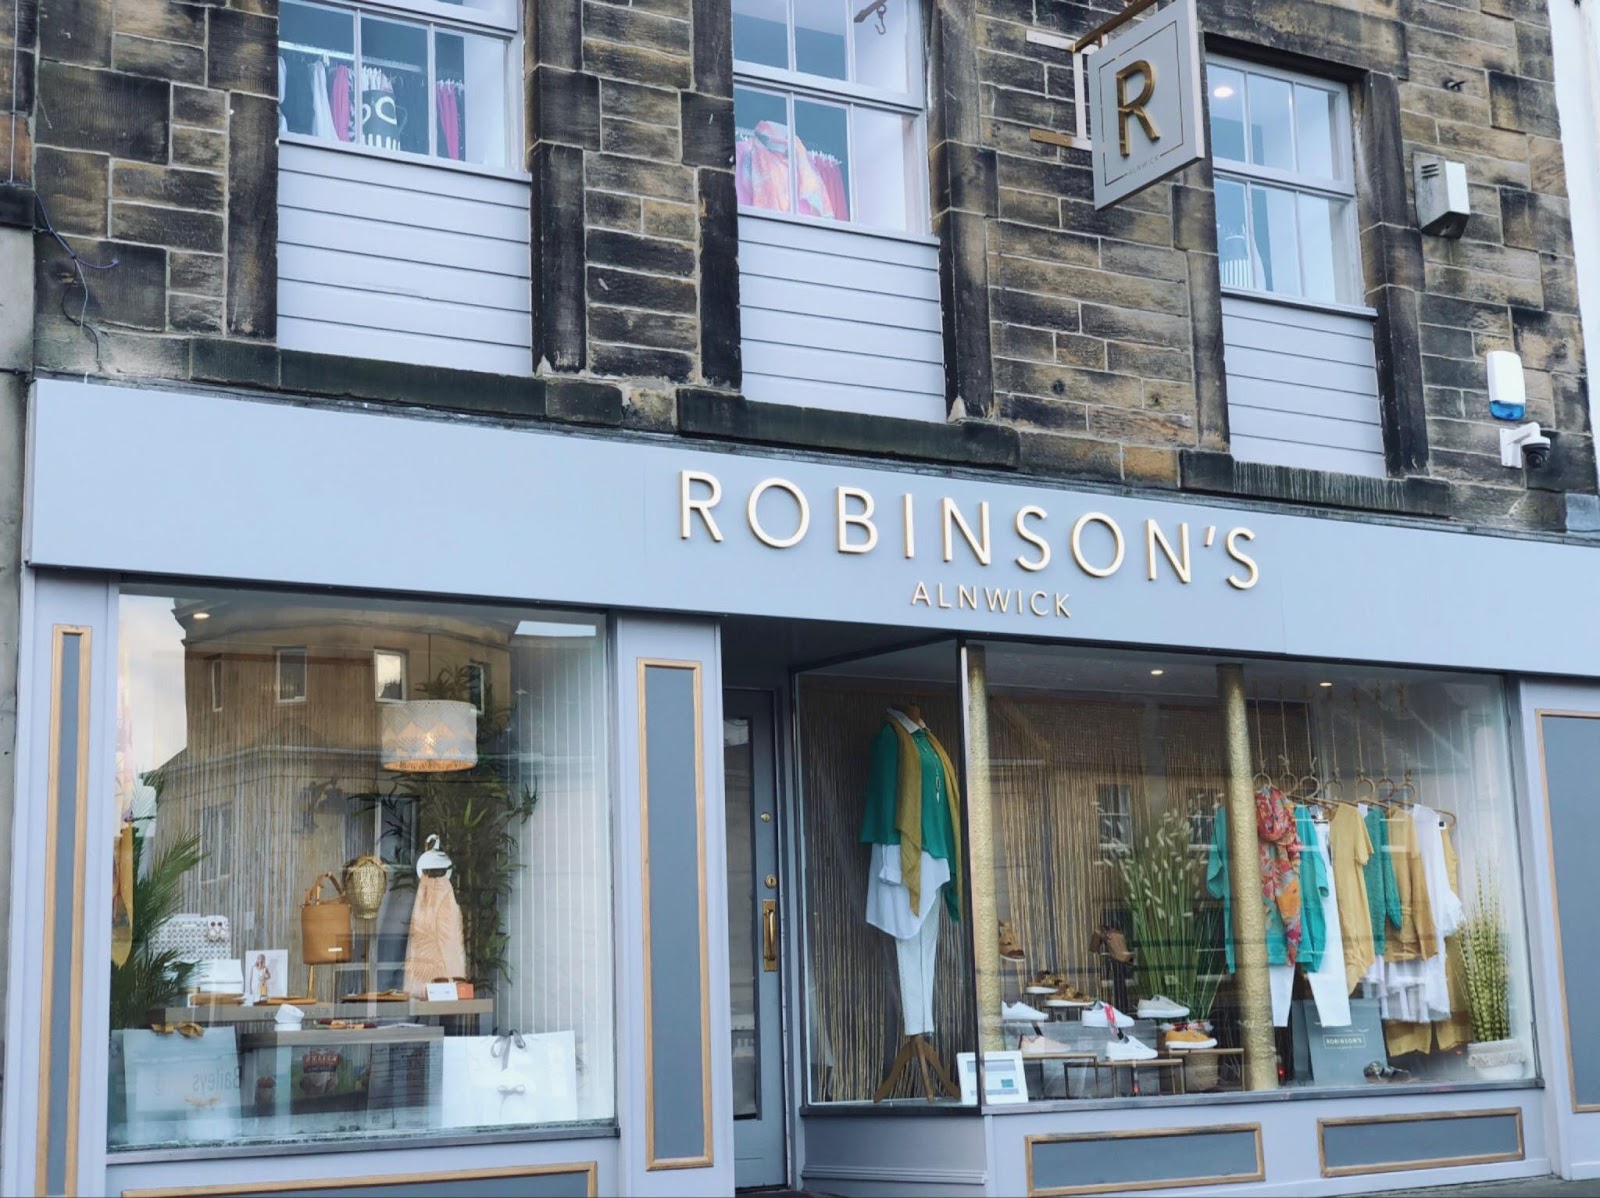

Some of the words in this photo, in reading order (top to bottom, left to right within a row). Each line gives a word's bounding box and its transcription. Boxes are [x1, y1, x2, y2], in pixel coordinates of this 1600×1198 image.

[1116, 59, 1161, 158] R
[679, 469, 1260, 590] ROBINSON'S
[911, 581, 1071, 618] ALNWICK
